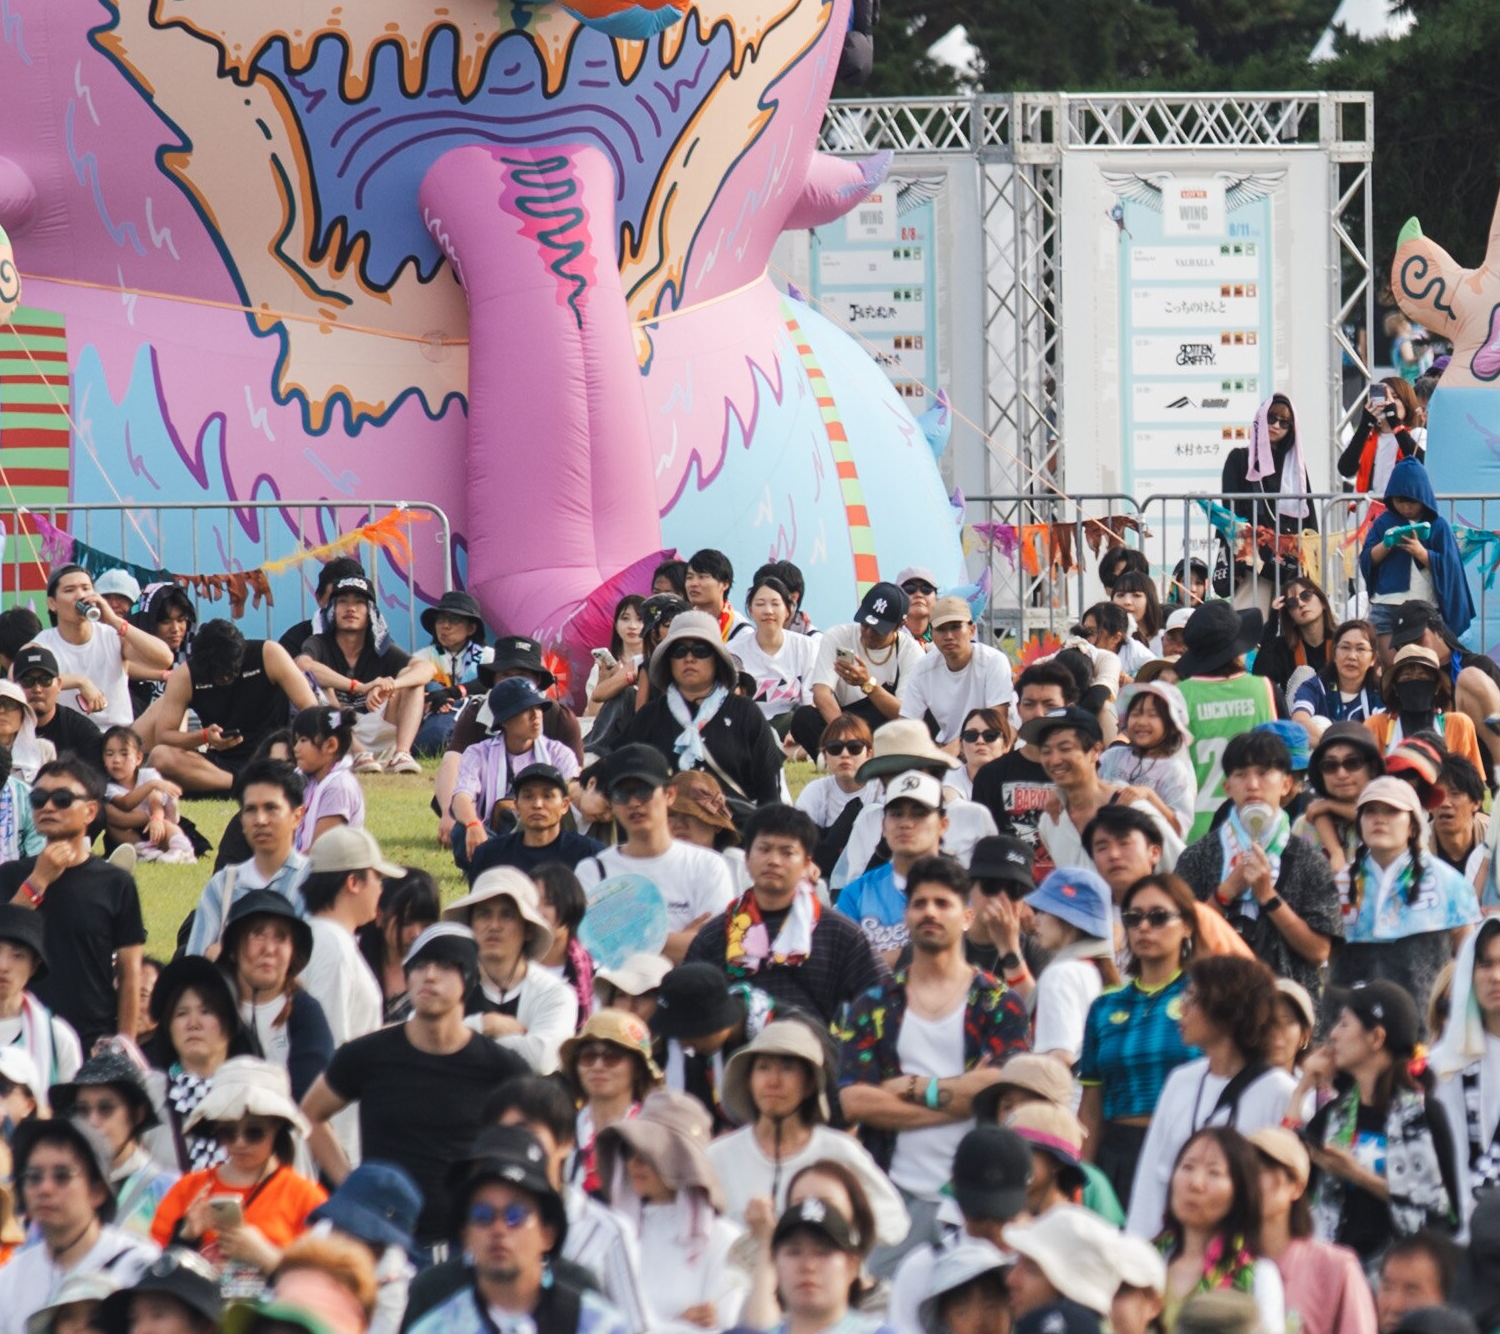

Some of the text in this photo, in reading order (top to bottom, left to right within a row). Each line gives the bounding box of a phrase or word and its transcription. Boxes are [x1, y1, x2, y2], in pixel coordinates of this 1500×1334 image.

[860, 210, 885, 226] WING
[1179, 205, 1209, 221] WING
[901, 227, 917, 241] 8/8
[1229, 223, 1250, 237] 8/11
[1164, 300, 1227, 315] こっちのけんと
[1175, 443, 1221, 456] 木村カエラ
[872, 597, 888, 614] NY
[1197, 698, 1256, 721] LUCKYFES
[1015, 787, 1051, 810] BABY
